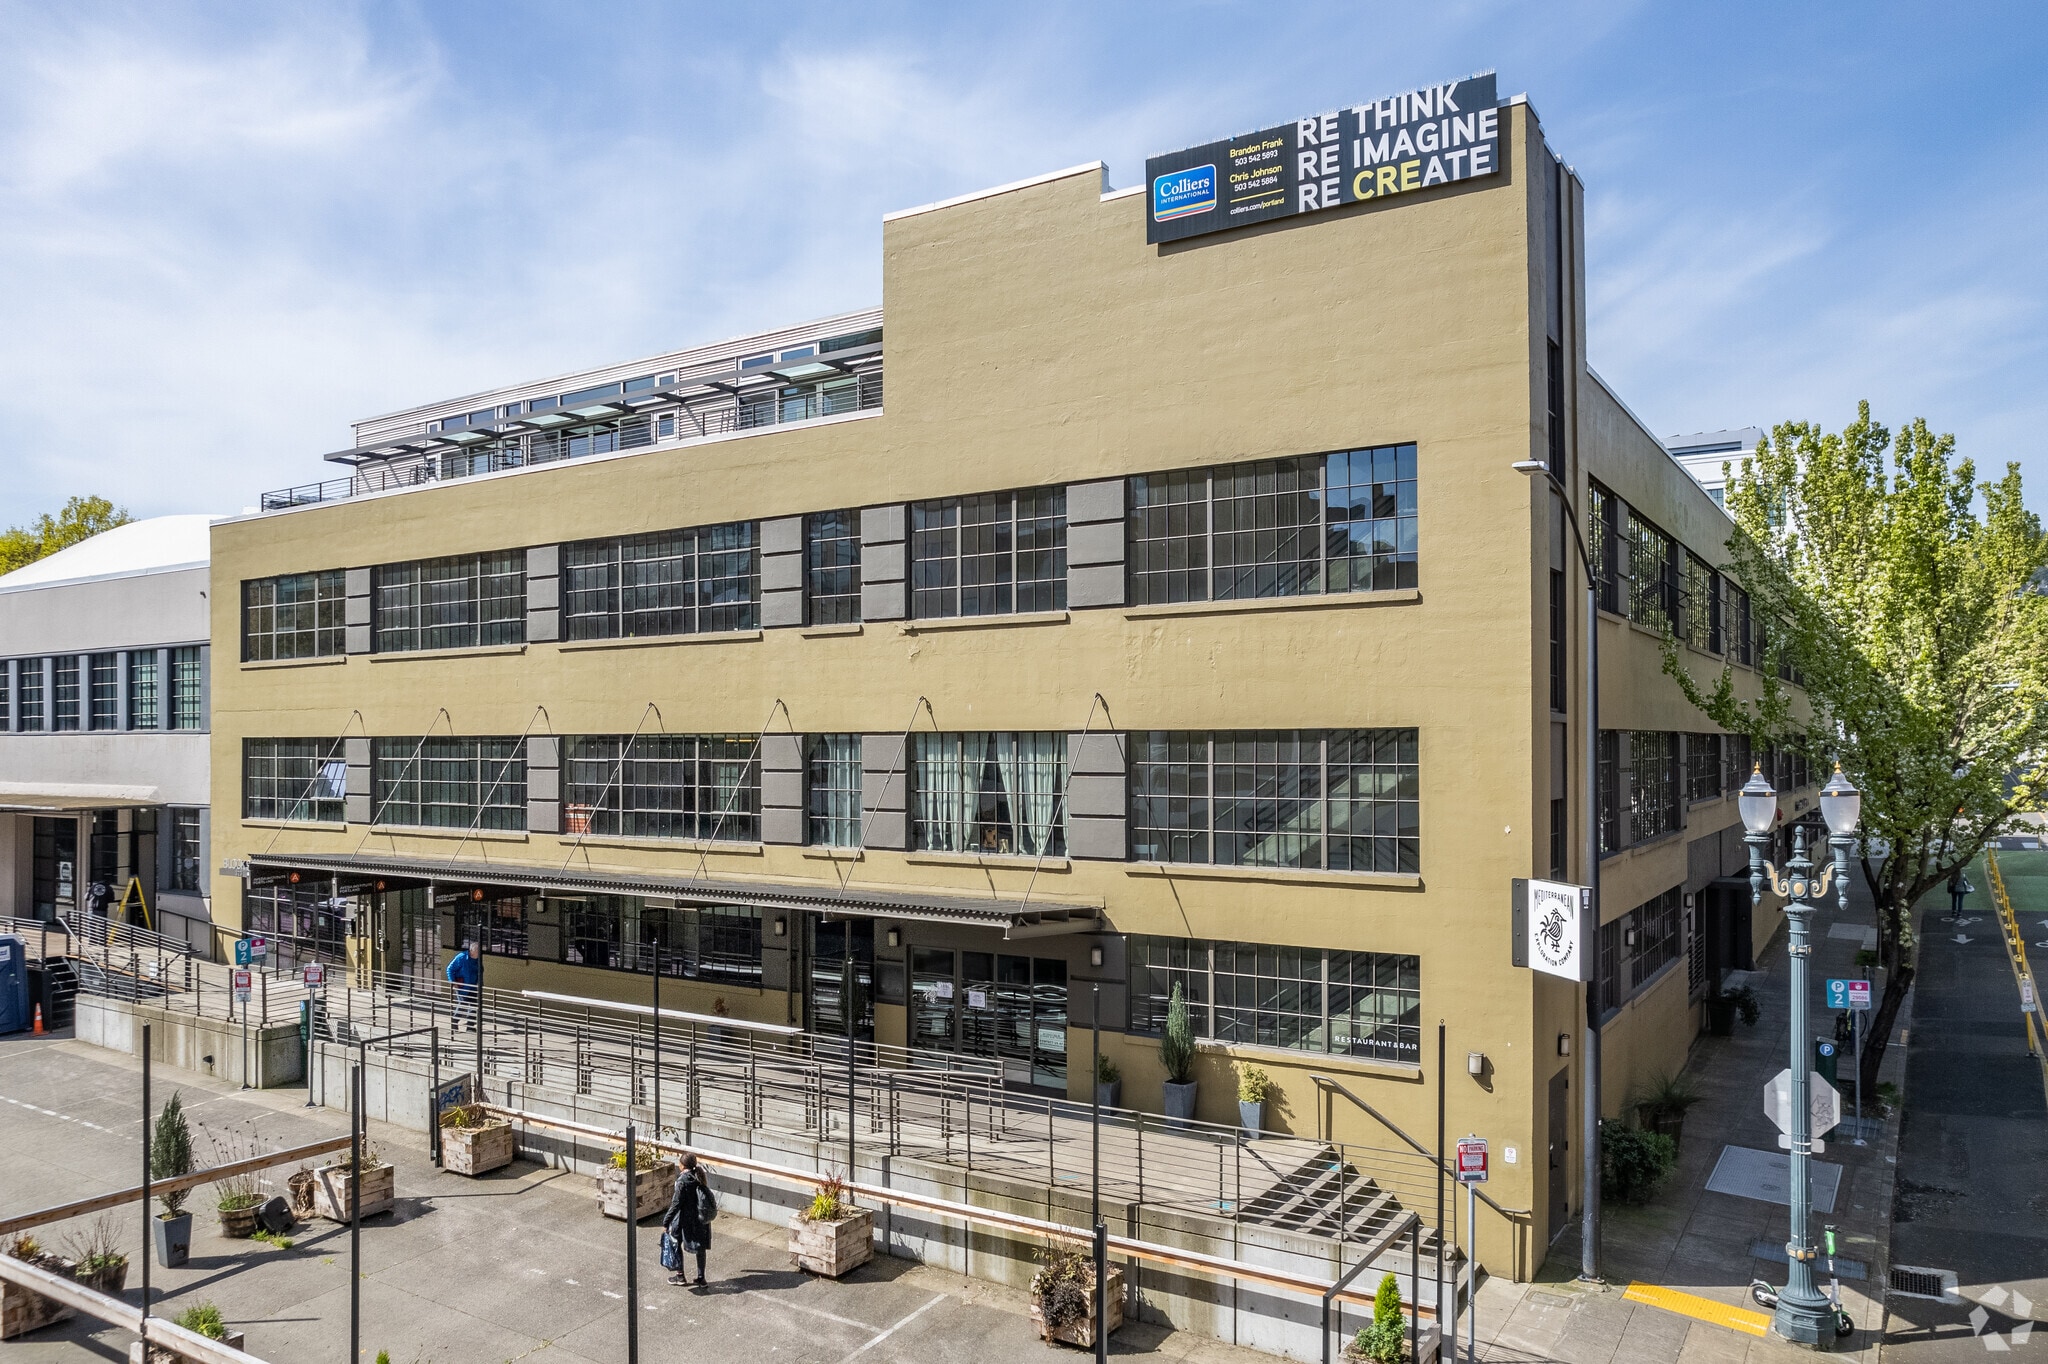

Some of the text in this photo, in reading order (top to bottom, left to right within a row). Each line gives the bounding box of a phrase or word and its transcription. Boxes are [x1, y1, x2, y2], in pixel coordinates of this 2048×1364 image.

[1297, 82, 1460, 149] RE THINK
[1229, 137, 1283, 158] Brandon Frank
[1298, 107, 1498, 181] RE IMAGINE
[1234, 149, 1278, 167] 503 542 5893
[1229, 165, 1282, 183] Chris Johnson
[1298, 144, 1492, 214] RE CREATE
[1160, 177, 1210, 197] Colliers
[1234, 182, 1247, 192] 503
[1247, 179, 1260, 189] 542
[1160, 189, 1210, 204] INTERNATIONAL
[1533, 889, 1574, 920] MEDITERRANEAN
[240, 951, 247, 961] 2
[1534, 933, 1574, 967] EXPLORATION COMPANY
[1834, 993, 1844, 1004] 2
